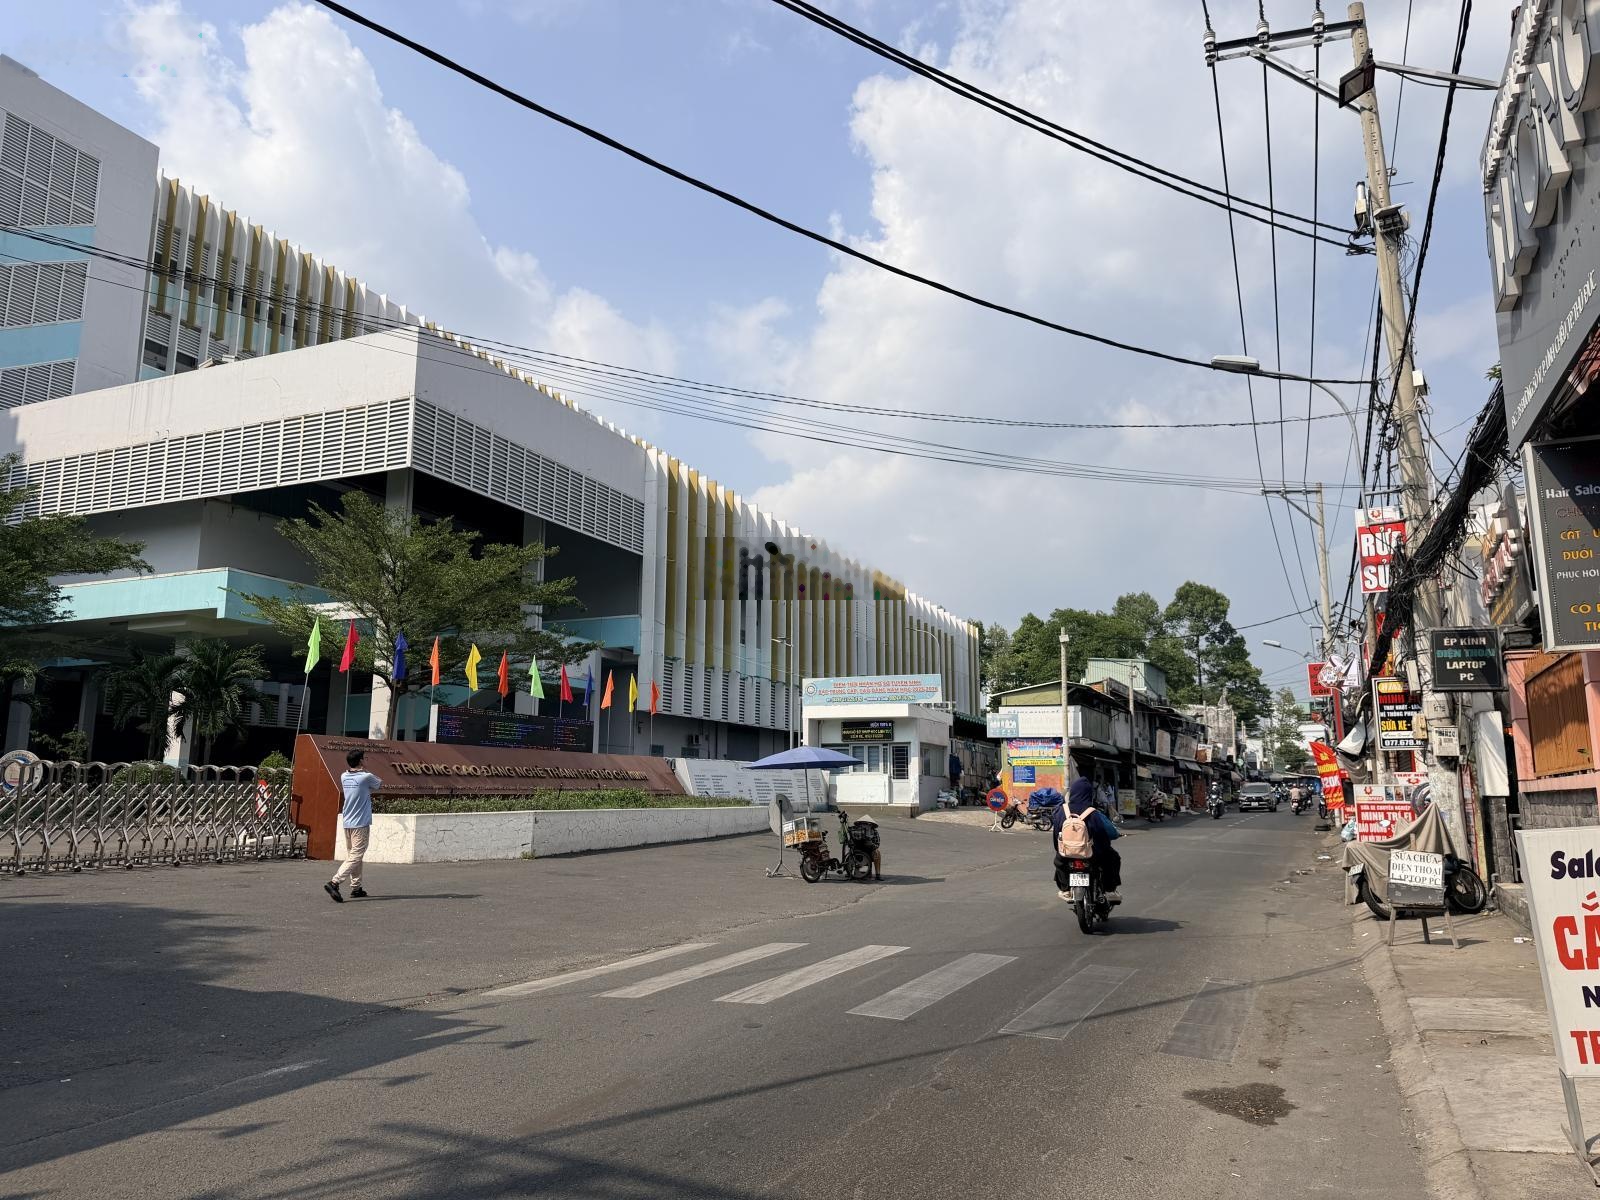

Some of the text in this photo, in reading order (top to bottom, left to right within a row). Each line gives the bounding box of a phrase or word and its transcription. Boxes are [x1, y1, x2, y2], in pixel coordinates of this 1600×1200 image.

[1545, 487, 1571, 499] Hair
[1556, 570, 1580, 582] PHỤC
[1443, 636, 1487, 646] ÉP KÍNH
[1446, 660, 1486, 670] LAPTOP
[1459, 672, 1475, 681] PC
[1381, 718, 1408, 731] SỬA XE
[452, 763, 481, 777] CAO
[1361, 811, 1384, 821] MINH
[1414, 864, 1441, 877] THOẠI
[1391, 872, 1441, 886] LAPTOP PC
